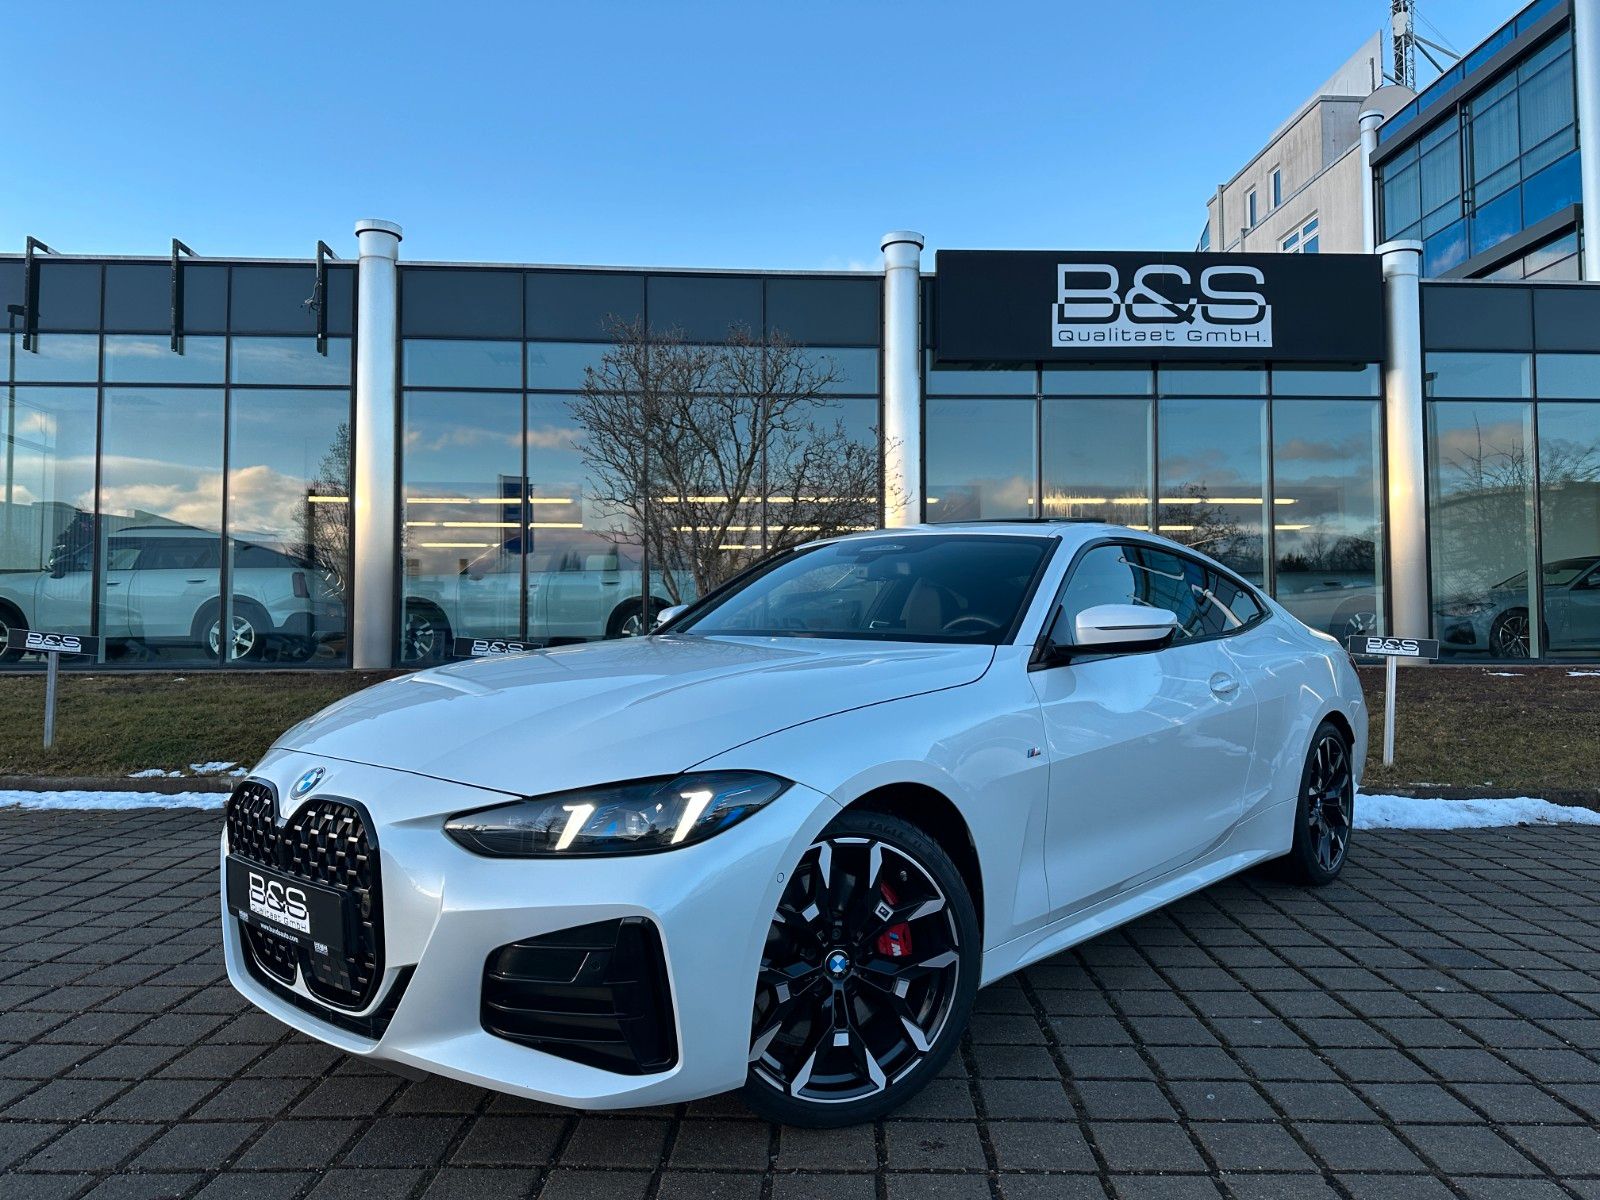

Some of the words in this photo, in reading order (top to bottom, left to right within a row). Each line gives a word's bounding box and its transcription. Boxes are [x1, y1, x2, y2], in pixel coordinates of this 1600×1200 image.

[1057, 264, 1266, 326] B&S
[1058, 327, 1176, 343] Qualitaet
[1187, 328, 1267, 343] GmbH.
[27, 632, 81, 649] B&S
[473, 640, 524, 654] B&S
[1367, 637, 1418, 652] B&S
[249, 871, 308, 921] B&S
